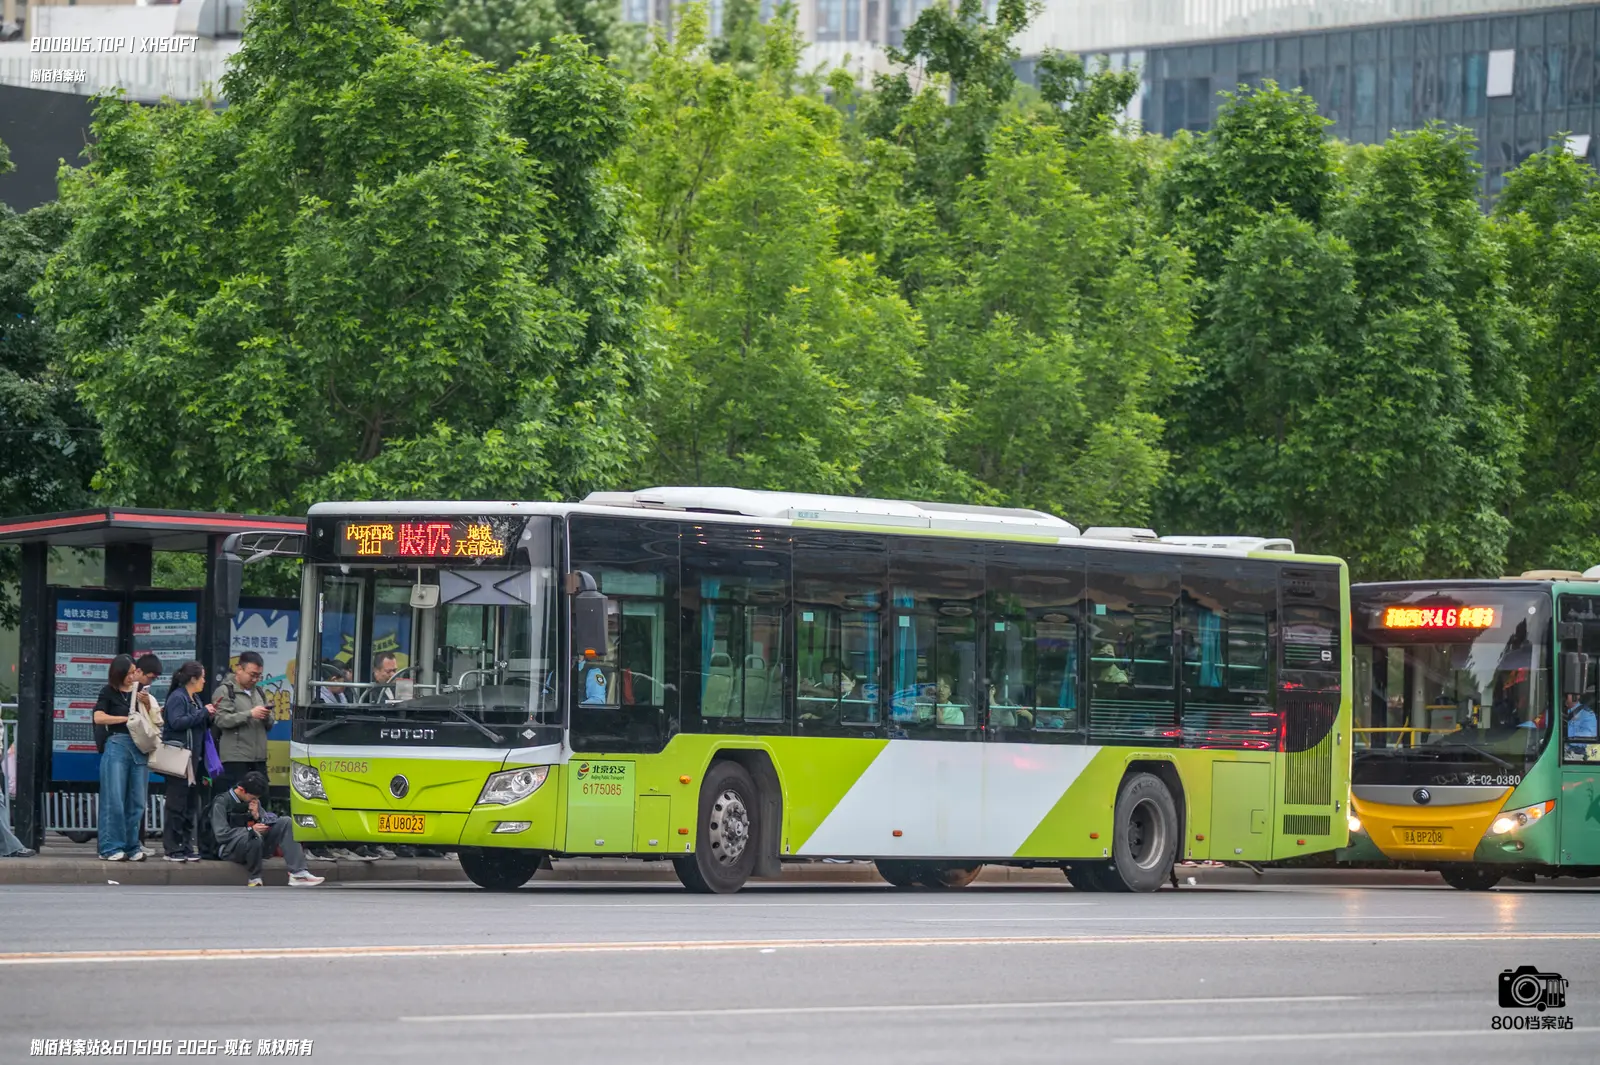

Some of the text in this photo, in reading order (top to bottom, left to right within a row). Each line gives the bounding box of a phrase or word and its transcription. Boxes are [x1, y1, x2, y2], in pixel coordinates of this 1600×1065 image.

[347, 524, 394, 540] 内环西路
[467, 524, 492, 540] 地铁
[399, 523, 452, 555] 快专175
[358, 539, 382, 555] 北口
[455, 540, 504, 556] 天宫院站
[63, 608, 109, 620] 地铁义和庄站
[142, 611, 189, 621] 地铁义和庄站
[380, 728, 434, 740] FOTON
[319, 761, 369, 774] 6175085
[592, 765, 626, 774] 北京公交
[1466, 775, 1521, 786] 兴-02-0380
[582, 783, 622, 796] 6175085
